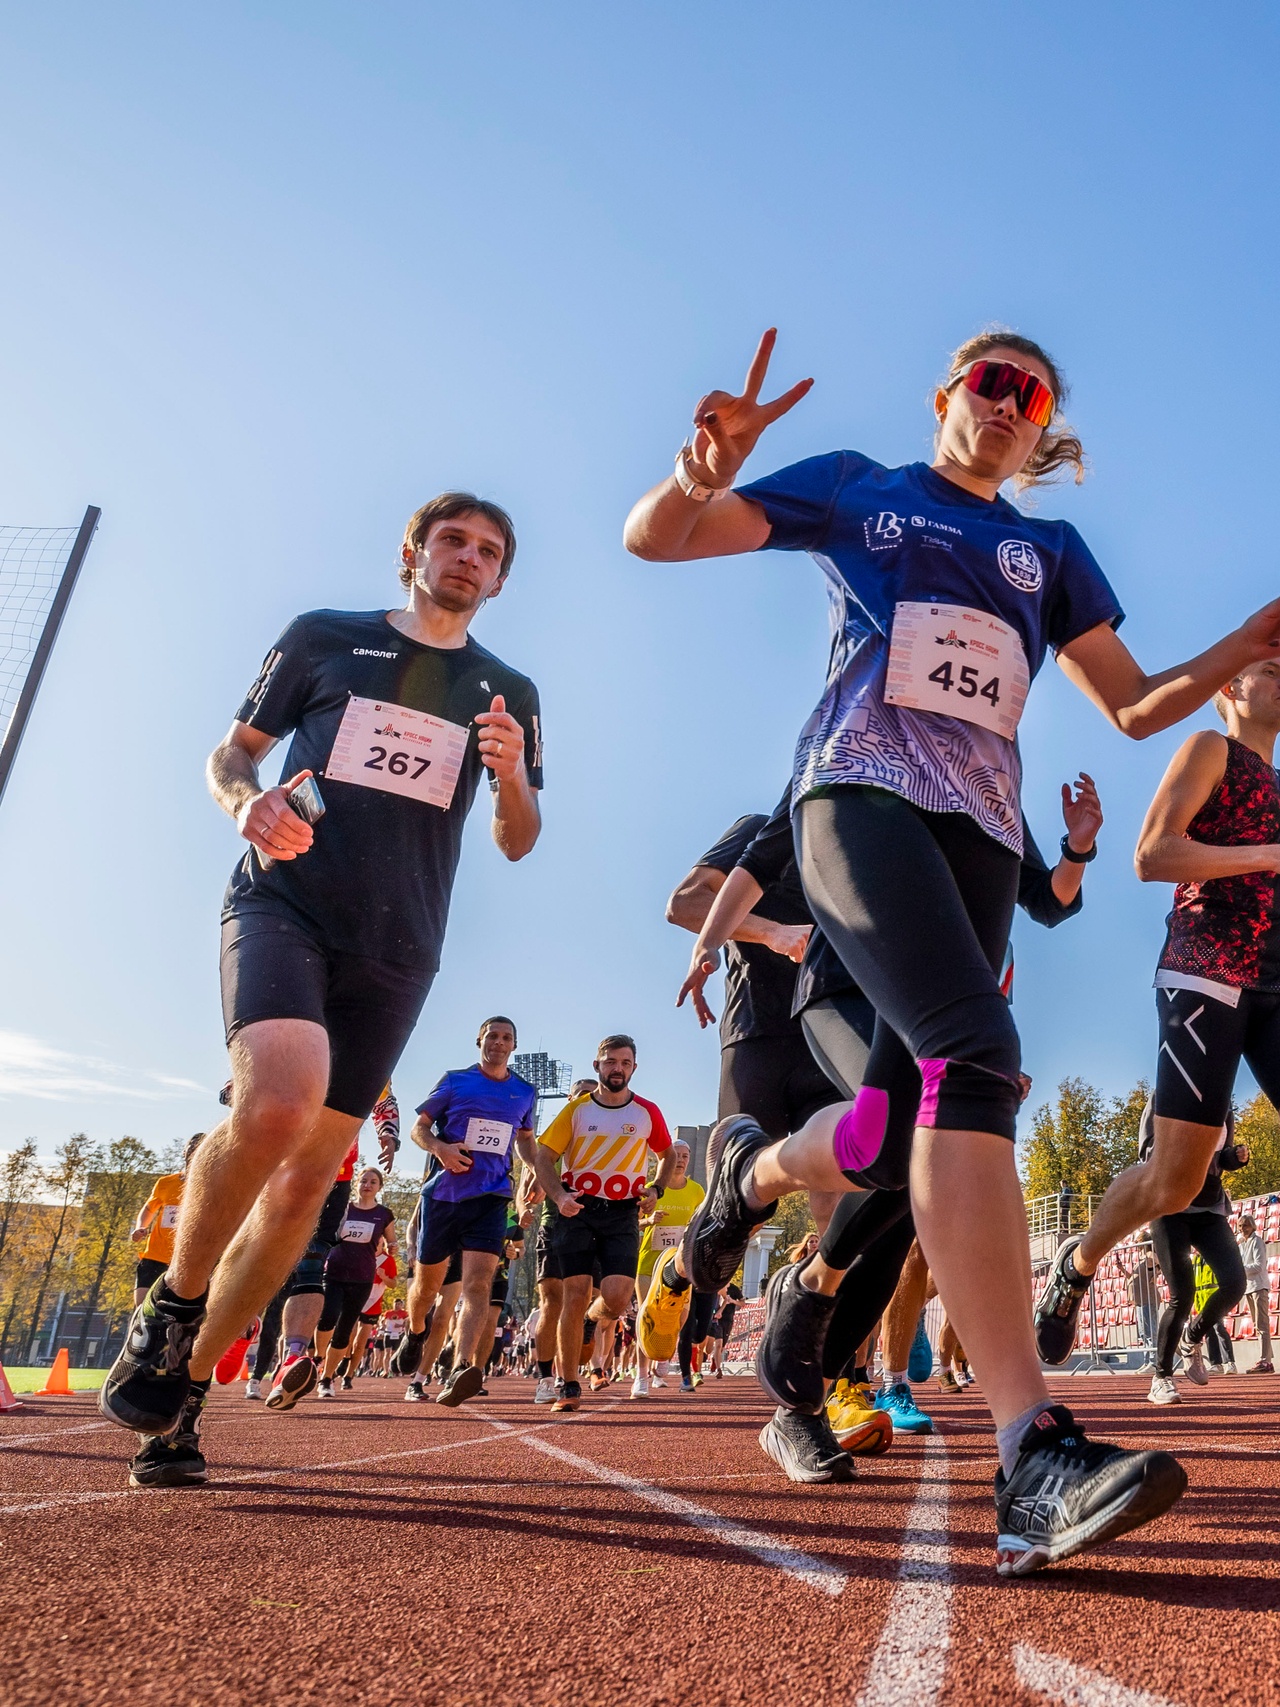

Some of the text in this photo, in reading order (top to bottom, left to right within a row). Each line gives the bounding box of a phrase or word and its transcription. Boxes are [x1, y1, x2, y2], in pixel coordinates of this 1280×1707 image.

[927, 520, 963, 536] ГАММА
[352, 647, 399, 660] самолет
[928, 660, 1001, 708] 454
[363, 745, 432, 781] 267
[476, 1135, 501, 1147] 279
[348, 1230, 364, 1239] 187
[661, 1238, 676, 1246] 151
